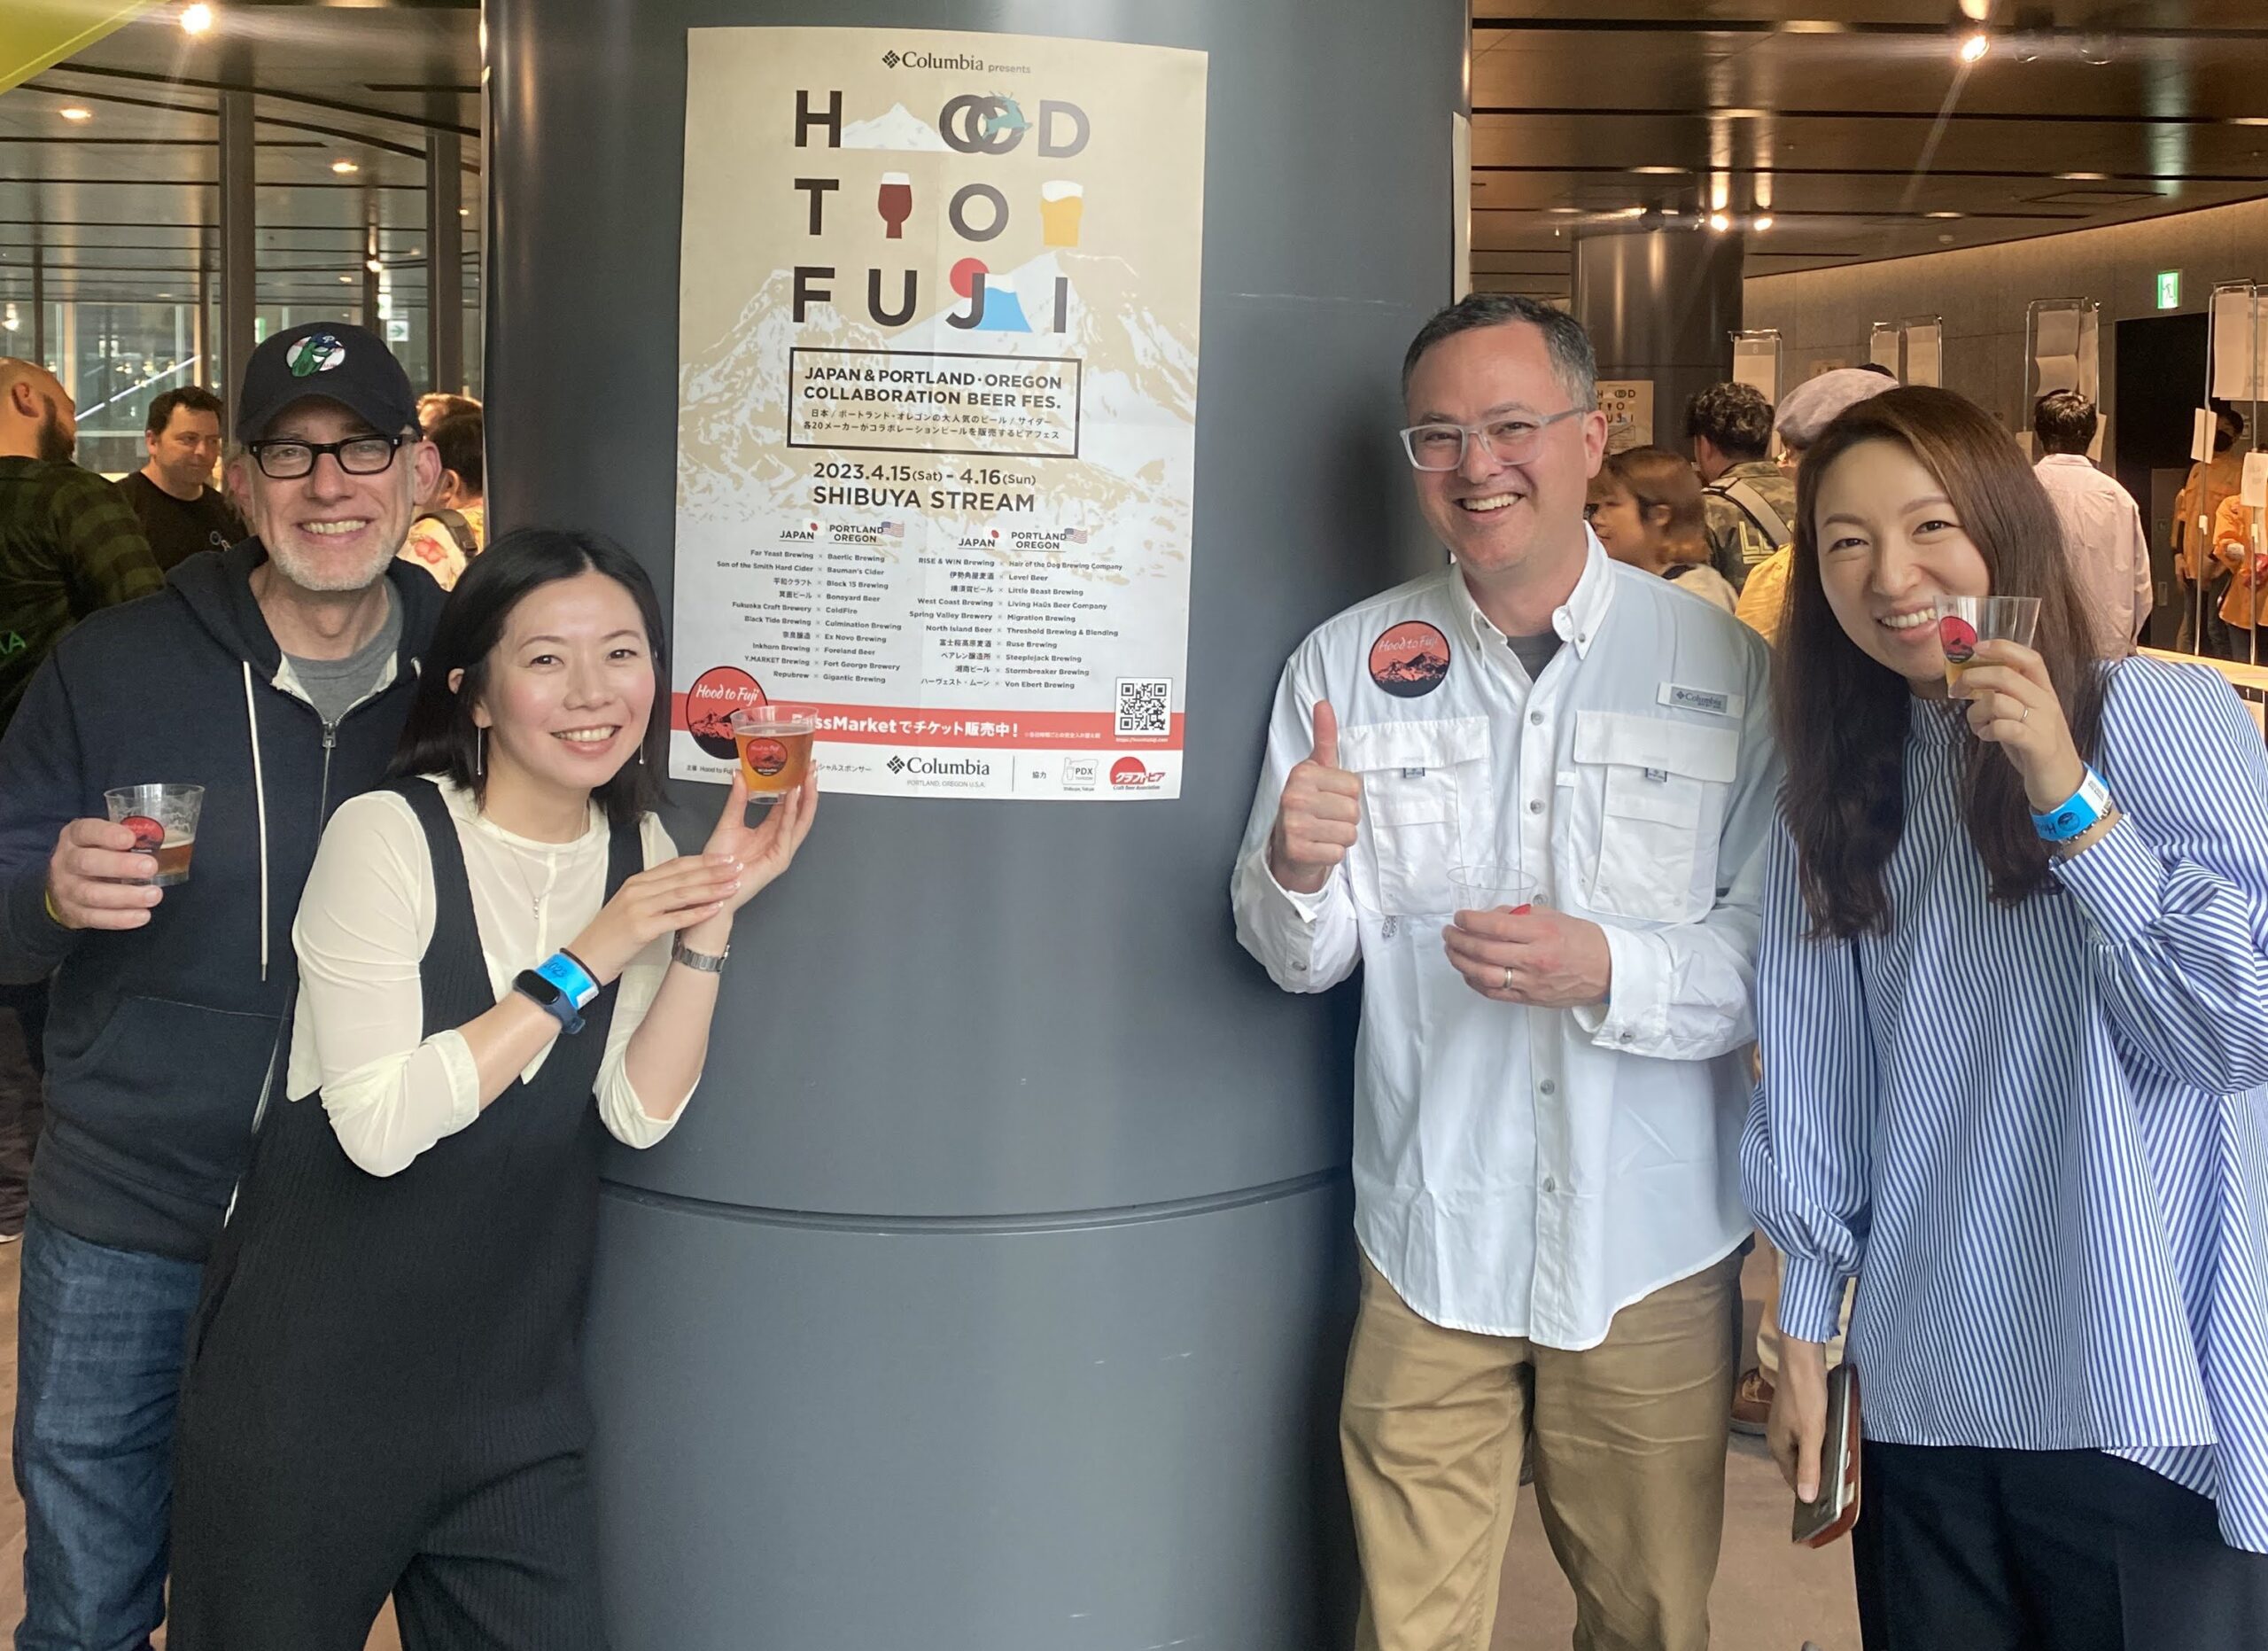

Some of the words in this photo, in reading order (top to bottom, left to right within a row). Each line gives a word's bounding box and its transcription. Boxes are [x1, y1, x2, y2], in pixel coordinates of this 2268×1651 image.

[902, 51, 983, 72] Columbia
[988, 64, 1031, 74] presents
[793, 266, 1068, 334] FUJI
[804, 367, 861, 381] JAPAN
[865, 370, 875, 381] &
[804, 386, 961, 406] COLLABORATION
[967, 392, 1015, 408] BEER
[1021, 394, 1061, 409] FES.
[813, 487, 921, 508] SHIBUYA
[930, 490, 1035, 512] STREAM
[828, 525, 884, 534] PORTLAND
[780, 530, 814, 540] JAPAN
[1011, 532, 1067, 541] PORTLAND
[959, 538, 995, 548] JAPAN
[785, 550, 813, 559] Brewing
[855, 554, 885, 563] Brewing
[964, 558, 994, 567] Brewing
[1047, 560, 1060, 569] Dog
[858, 581, 889, 590] Brewing
[827, 593, 861, 602] Boneyard
[962, 598, 993, 607] Brewing
[782, 604, 812, 613] Brewery
[910, 610, 934, 619] Spring
[961, 611, 992, 620] Brewery
[1045, 614, 1076, 623] Brewing
[782, 617, 811, 627] Brewing
[871, 622, 901, 631] Brewing
[1046, 627, 1076, 636] Brewing
[1086, 628, 1118, 637] Blending
[857, 635, 886, 643] Brewing
[781, 644, 810, 653] Brewing
[1379, 637, 1407, 652] Hood
[781, 657, 810, 666] Brewing
[841, 660, 867, 669] George
[870, 662, 900, 671] Brewery
[856, 674, 885, 683] Brewing
[1045, 681, 1075, 689] Brewing
[696, 683, 725, 699] Hood
[725, 688, 736, 700] to
[737, 687, 760, 706] Fuji
[817, 763, 873, 774] シャルスポンサー
[906, 757, 990, 776] Columbia
